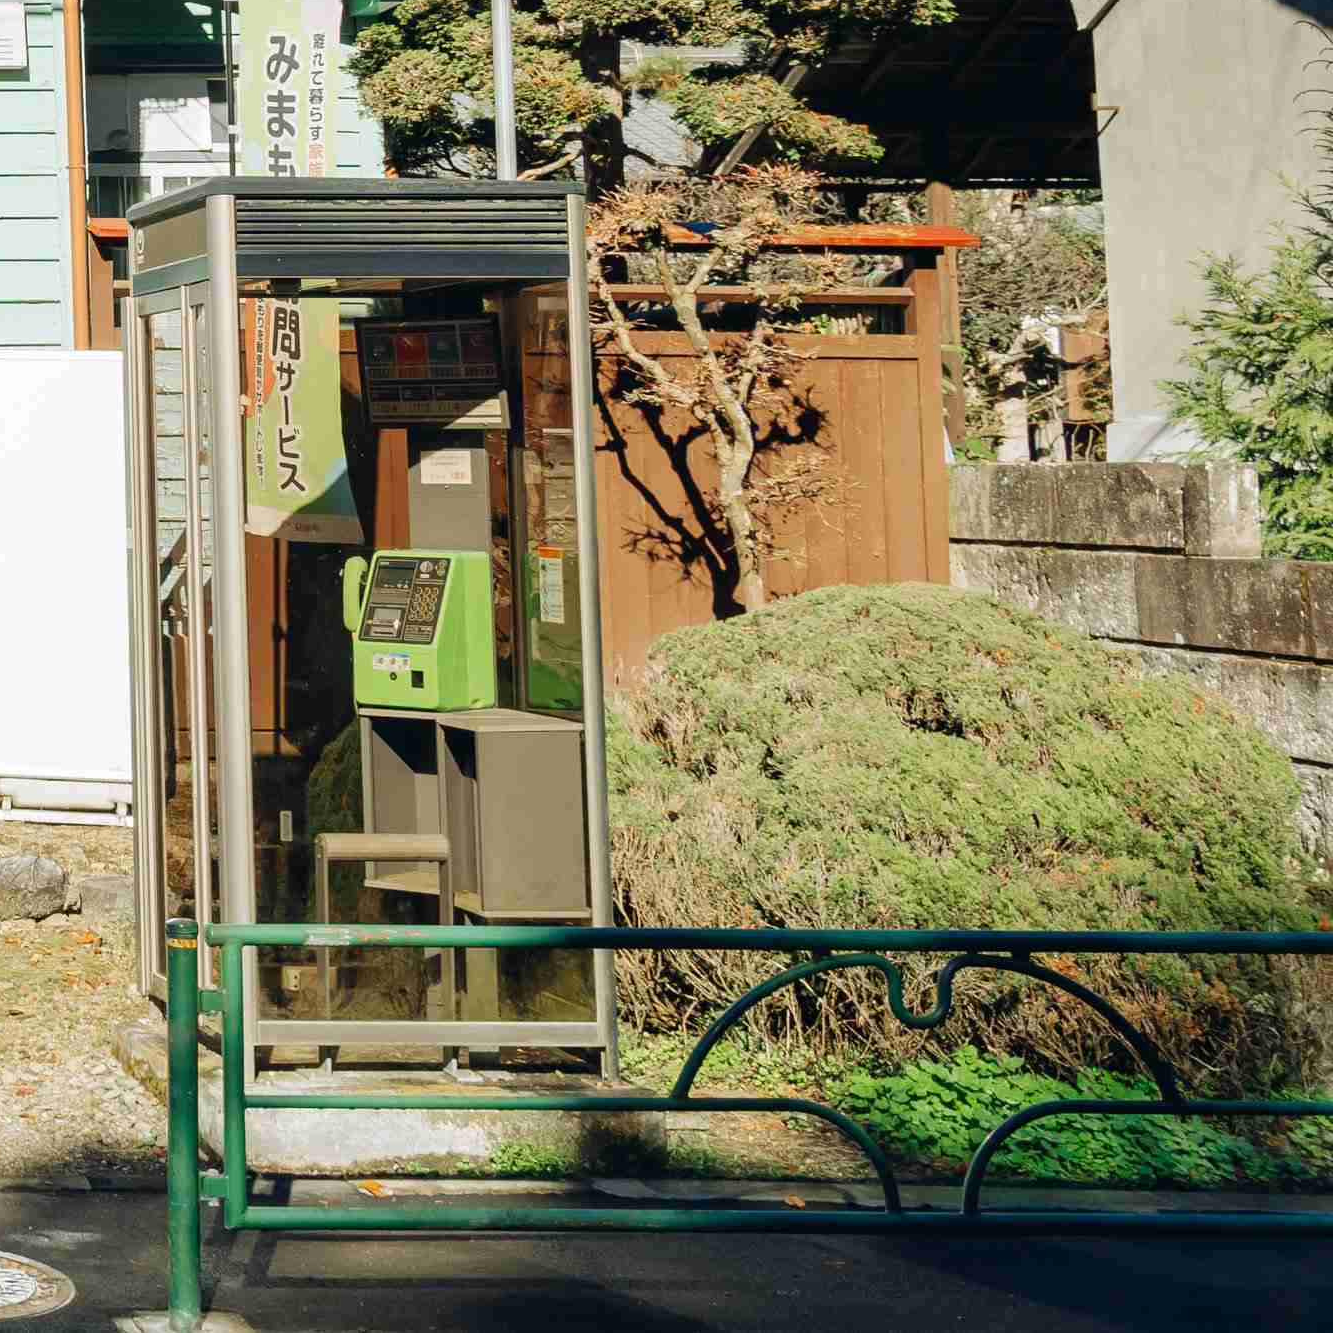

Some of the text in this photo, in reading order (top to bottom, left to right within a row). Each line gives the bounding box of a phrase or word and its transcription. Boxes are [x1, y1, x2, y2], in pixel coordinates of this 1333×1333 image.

[272, 298, 306, 492] 問サービス
